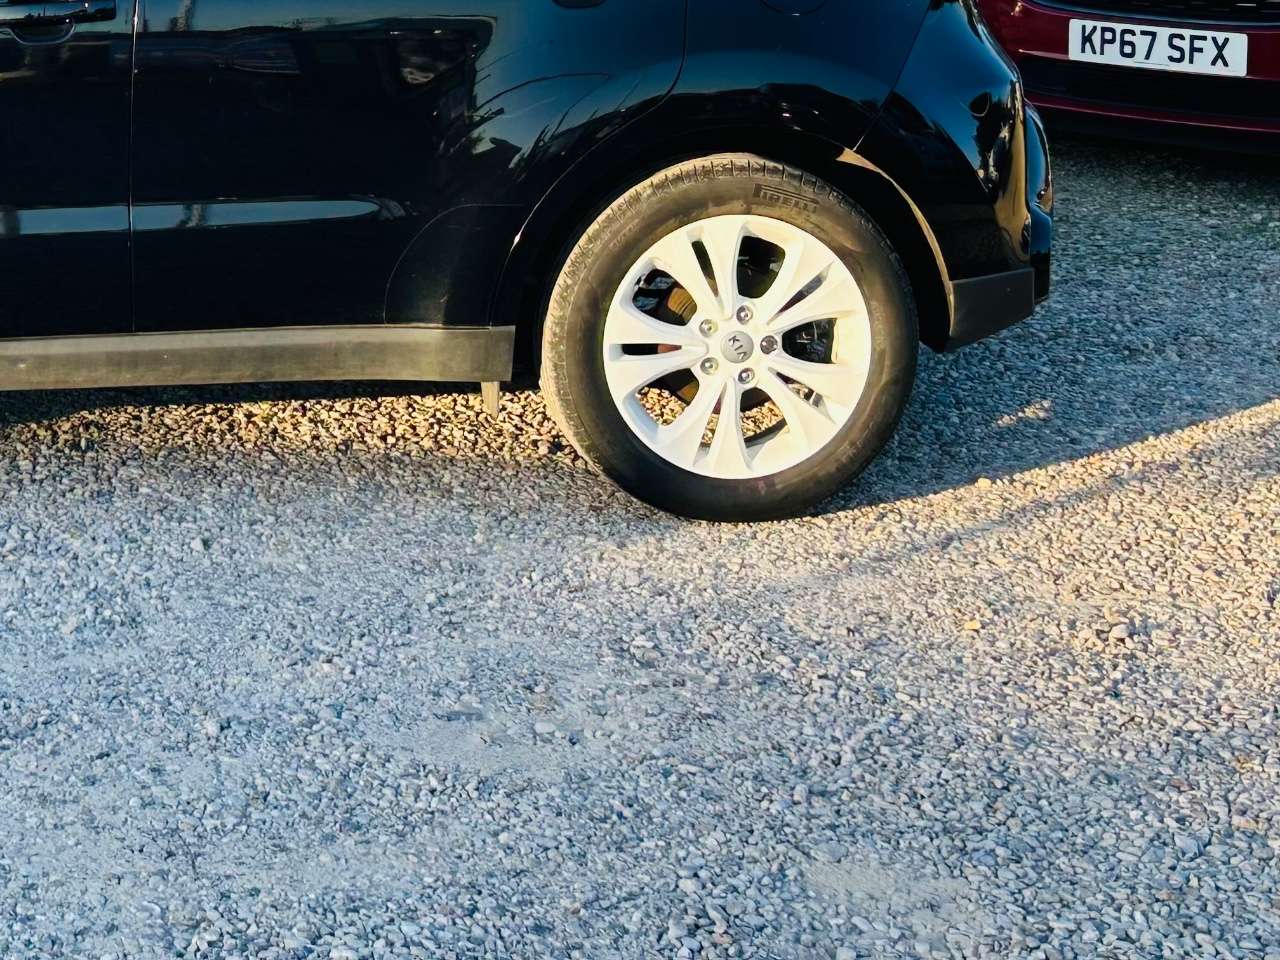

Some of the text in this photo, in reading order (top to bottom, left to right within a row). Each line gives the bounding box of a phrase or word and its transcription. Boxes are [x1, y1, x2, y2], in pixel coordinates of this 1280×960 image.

[1080, 24, 1230, 68] KP67 SFX
[728, 334, 748, 360] KIA
